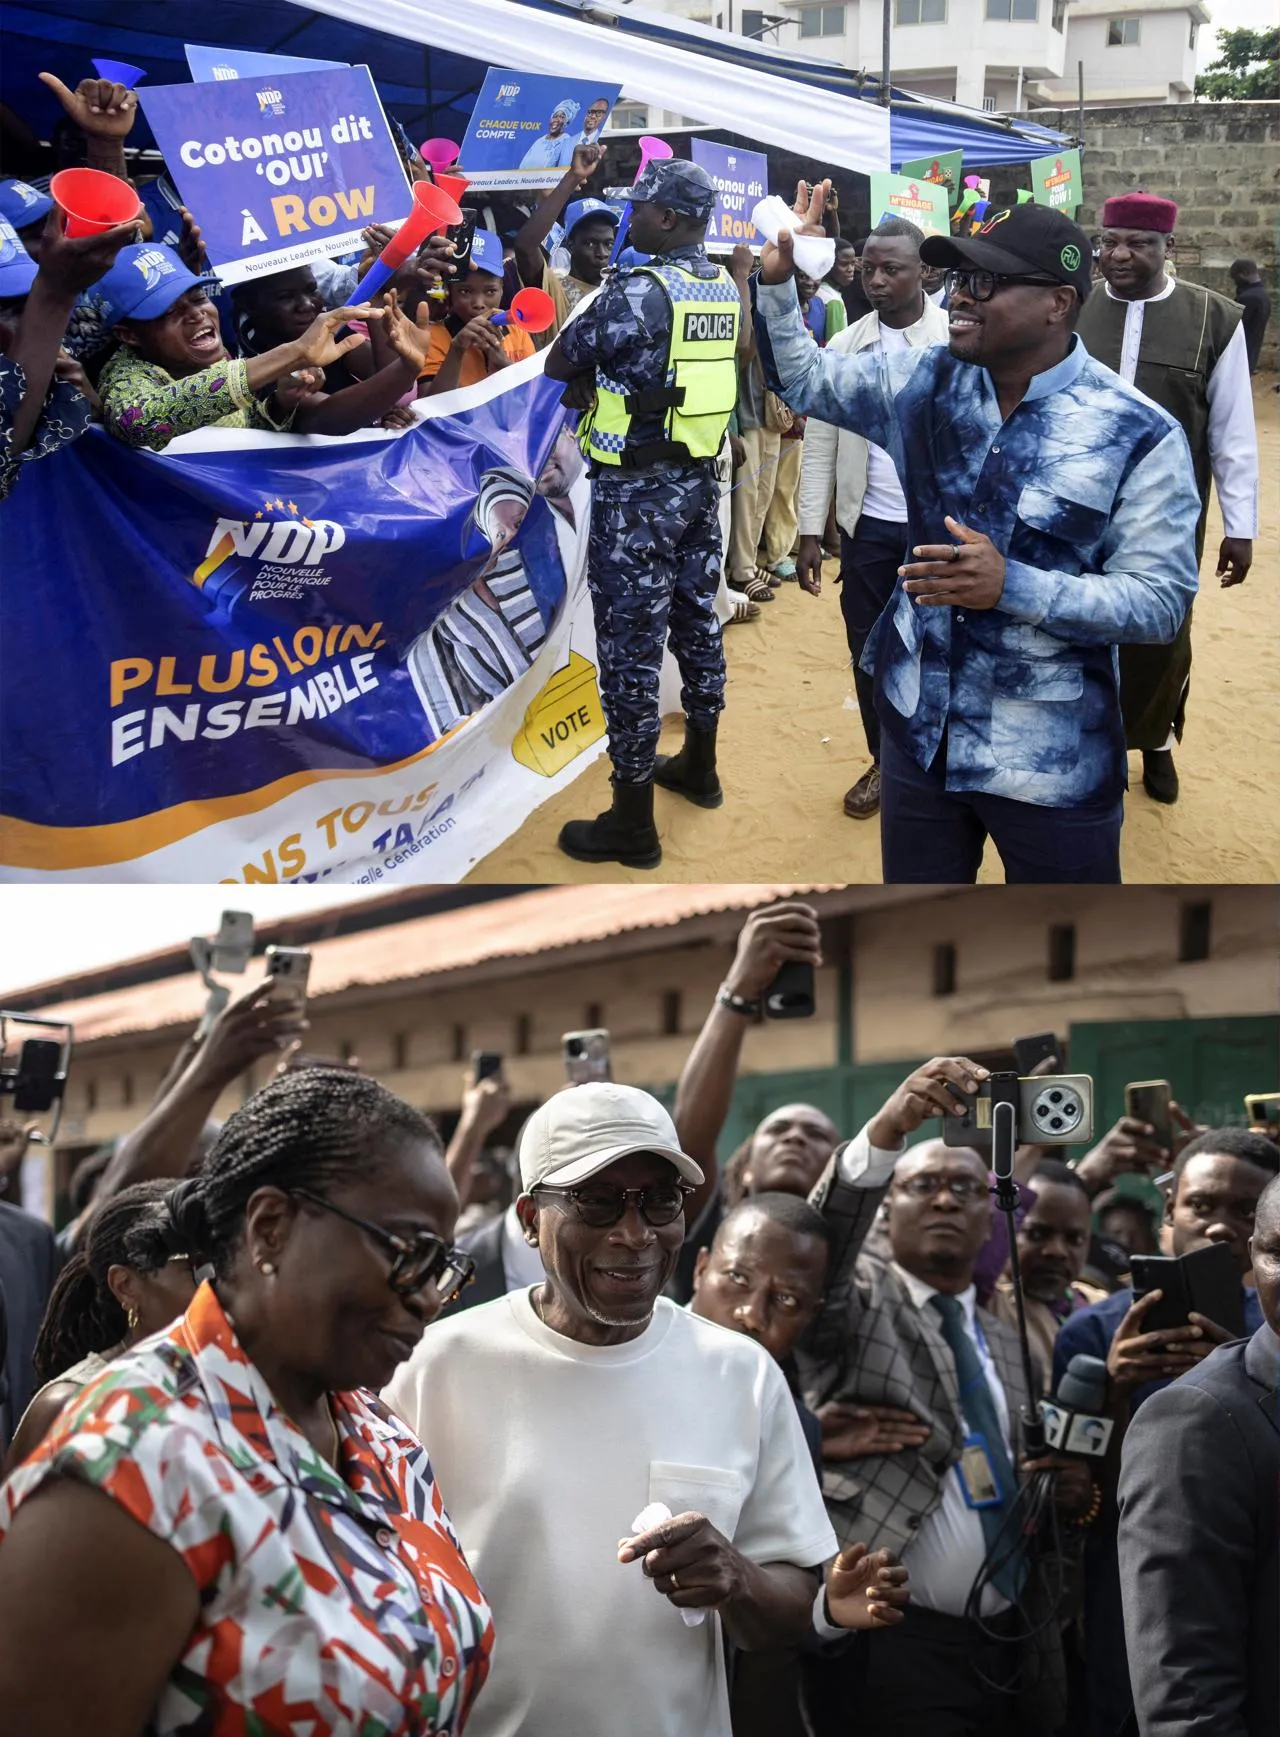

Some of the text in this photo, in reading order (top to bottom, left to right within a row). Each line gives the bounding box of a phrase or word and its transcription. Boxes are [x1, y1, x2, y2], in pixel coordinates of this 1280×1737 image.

[256, 90, 283, 105] NDP
[499, 84, 521, 97] NDP
[475, 129, 516, 140] COMPTE.
[479, 119, 542, 131] CHAQUE VOIX
[180, 114, 374, 169] Cotonou dit
[712, 176, 763, 197] tonou dit
[1049, 190, 1067, 207] ROW
[240, 185, 375, 246] À Row
[708, 214, 757, 239] À Row
[472, 237, 485, 248] DP
[132, 251, 167, 268] NDP
[245, 254, 289, 273] Nouveaux
[290, 246, 325, 265] Leaders,
[325, 236, 359, 253] Nouvelle
[687, 315, 733, 340] POLICE
[205, 517, 346, 566] NDP
[256, 572, 332, 586] DYNAMIQUE
[261, 565, 325, 577] NOUVELLE
[249, 590, 305, 602] PROGRÈS
[252, 580, 303, 592] POUR LE
[110, 622, 387, 708] PLUS LOIN,
[111, 652, 380, 767] ENSEMBLE
[540, 704, 592, 749] VOTE
[216, 782, 439, 884] NS TOUS
[384, 816, 457, 870] Génération
